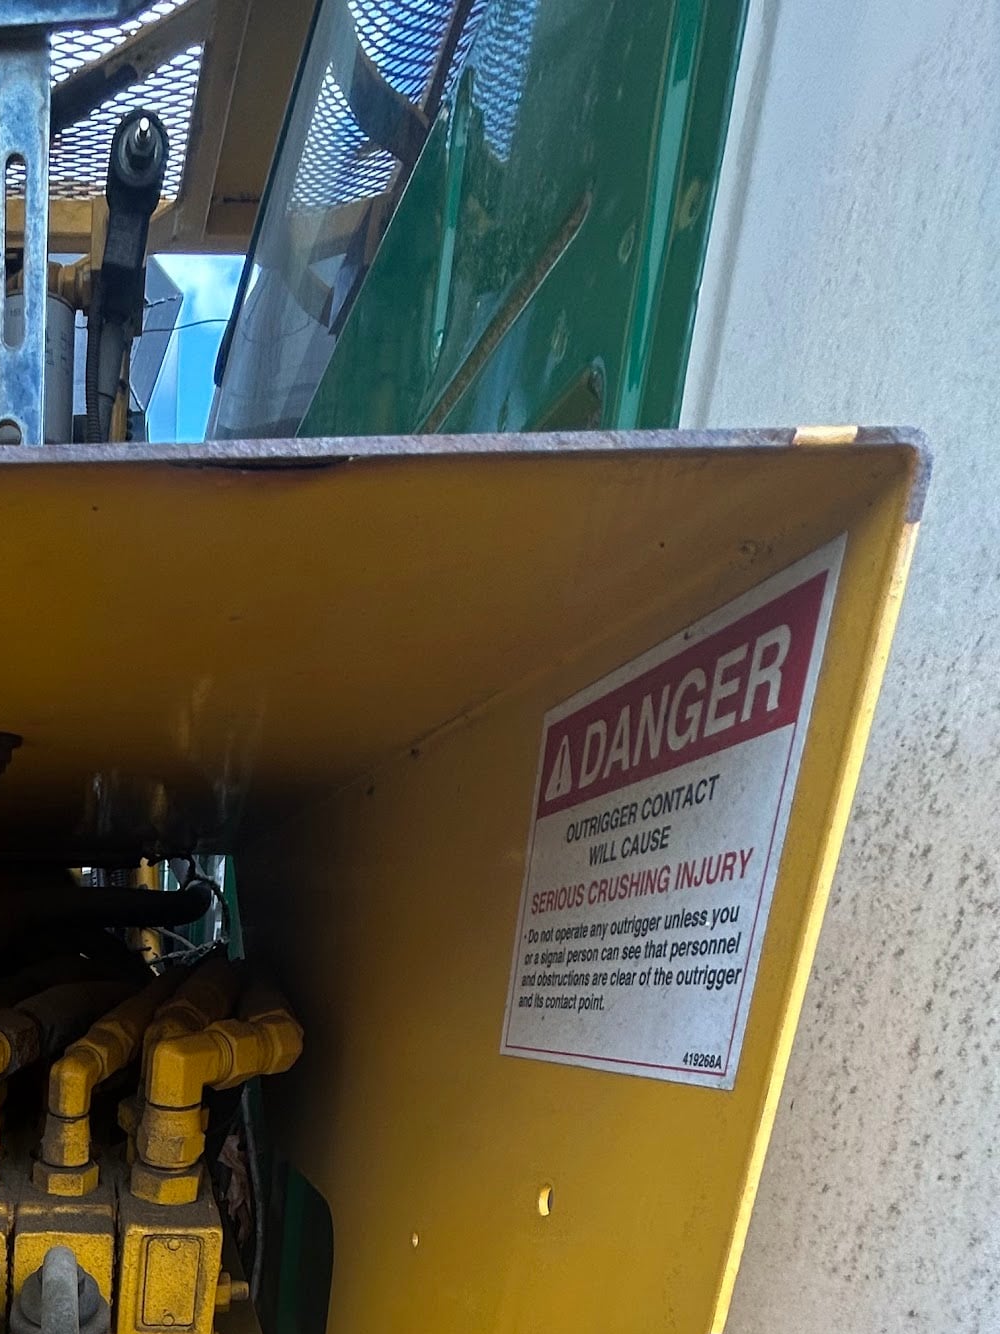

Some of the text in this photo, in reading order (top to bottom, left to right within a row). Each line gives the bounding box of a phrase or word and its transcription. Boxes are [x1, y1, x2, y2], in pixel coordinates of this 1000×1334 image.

[579, 624, 791, 789] DANGER
[566, 774, 720, 843] OUTRIGGER CONTACT
[589, 825, 671, 866] WILL CAUSE
[531, 847, 754, 915] SERIOUS CRUSHING INJURY
[528, 905, 740, 944] Do not operate any outrigger unless you
[525, 931, 742, 968] or a signal person can see that personnel
[521, 964, 742, 991] and obstructions are clear of the outrigger
[519, 992, 605, 1014] and its contact point.
[682, 1051, 722, 1070] 419268A
